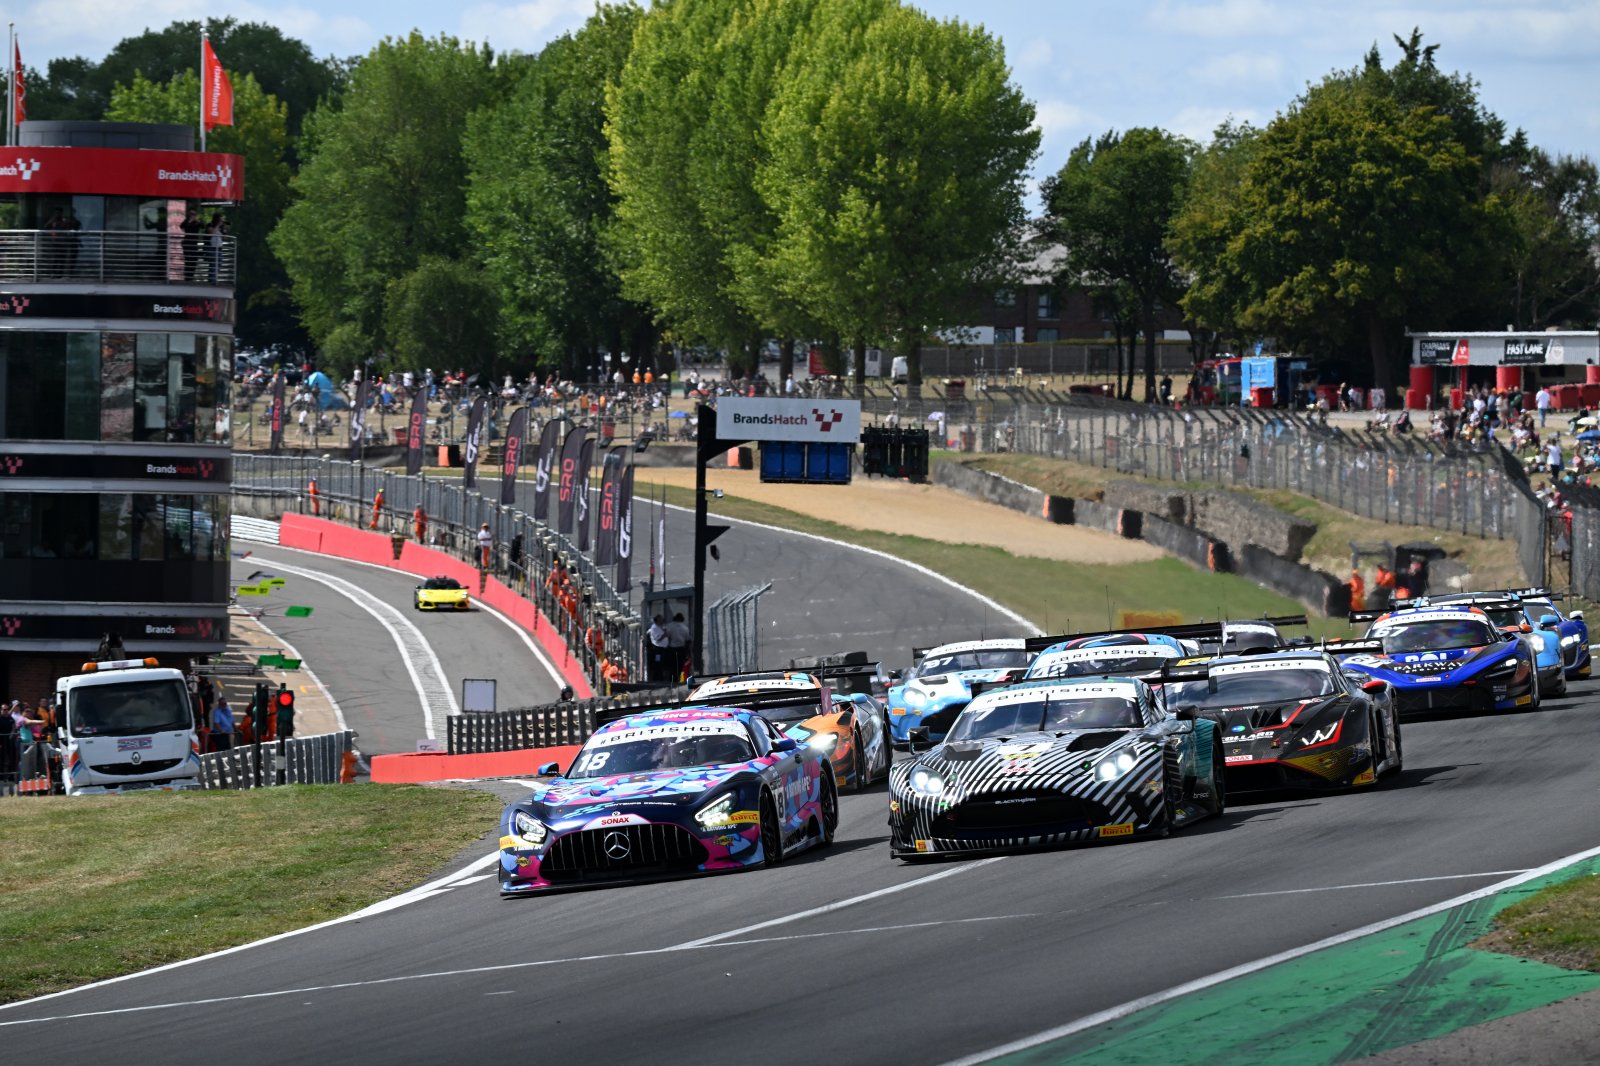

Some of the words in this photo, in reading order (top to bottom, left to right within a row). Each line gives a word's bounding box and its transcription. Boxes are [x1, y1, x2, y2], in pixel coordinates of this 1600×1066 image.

[158, 169, 218, 182] BrandsHatch
[1506, 343, 1524, 355] FAST
[1525, 343, 1544, 354] LANE
[733, 413, 808, 425] BrandsHatch
[505, 436, 519, 476] SRO
[560, 457, 575, 502] SRO
[1373, 626, 1409, 637] 67
[1033, 663, 1069, 678] 42
[1393, 661, 1465, 671] PARKWAY
[576, 752, 610, 773] 18
[601, 817, 630, 825] SONAX
[1102, 825, 1132, 836] PIRELLI
